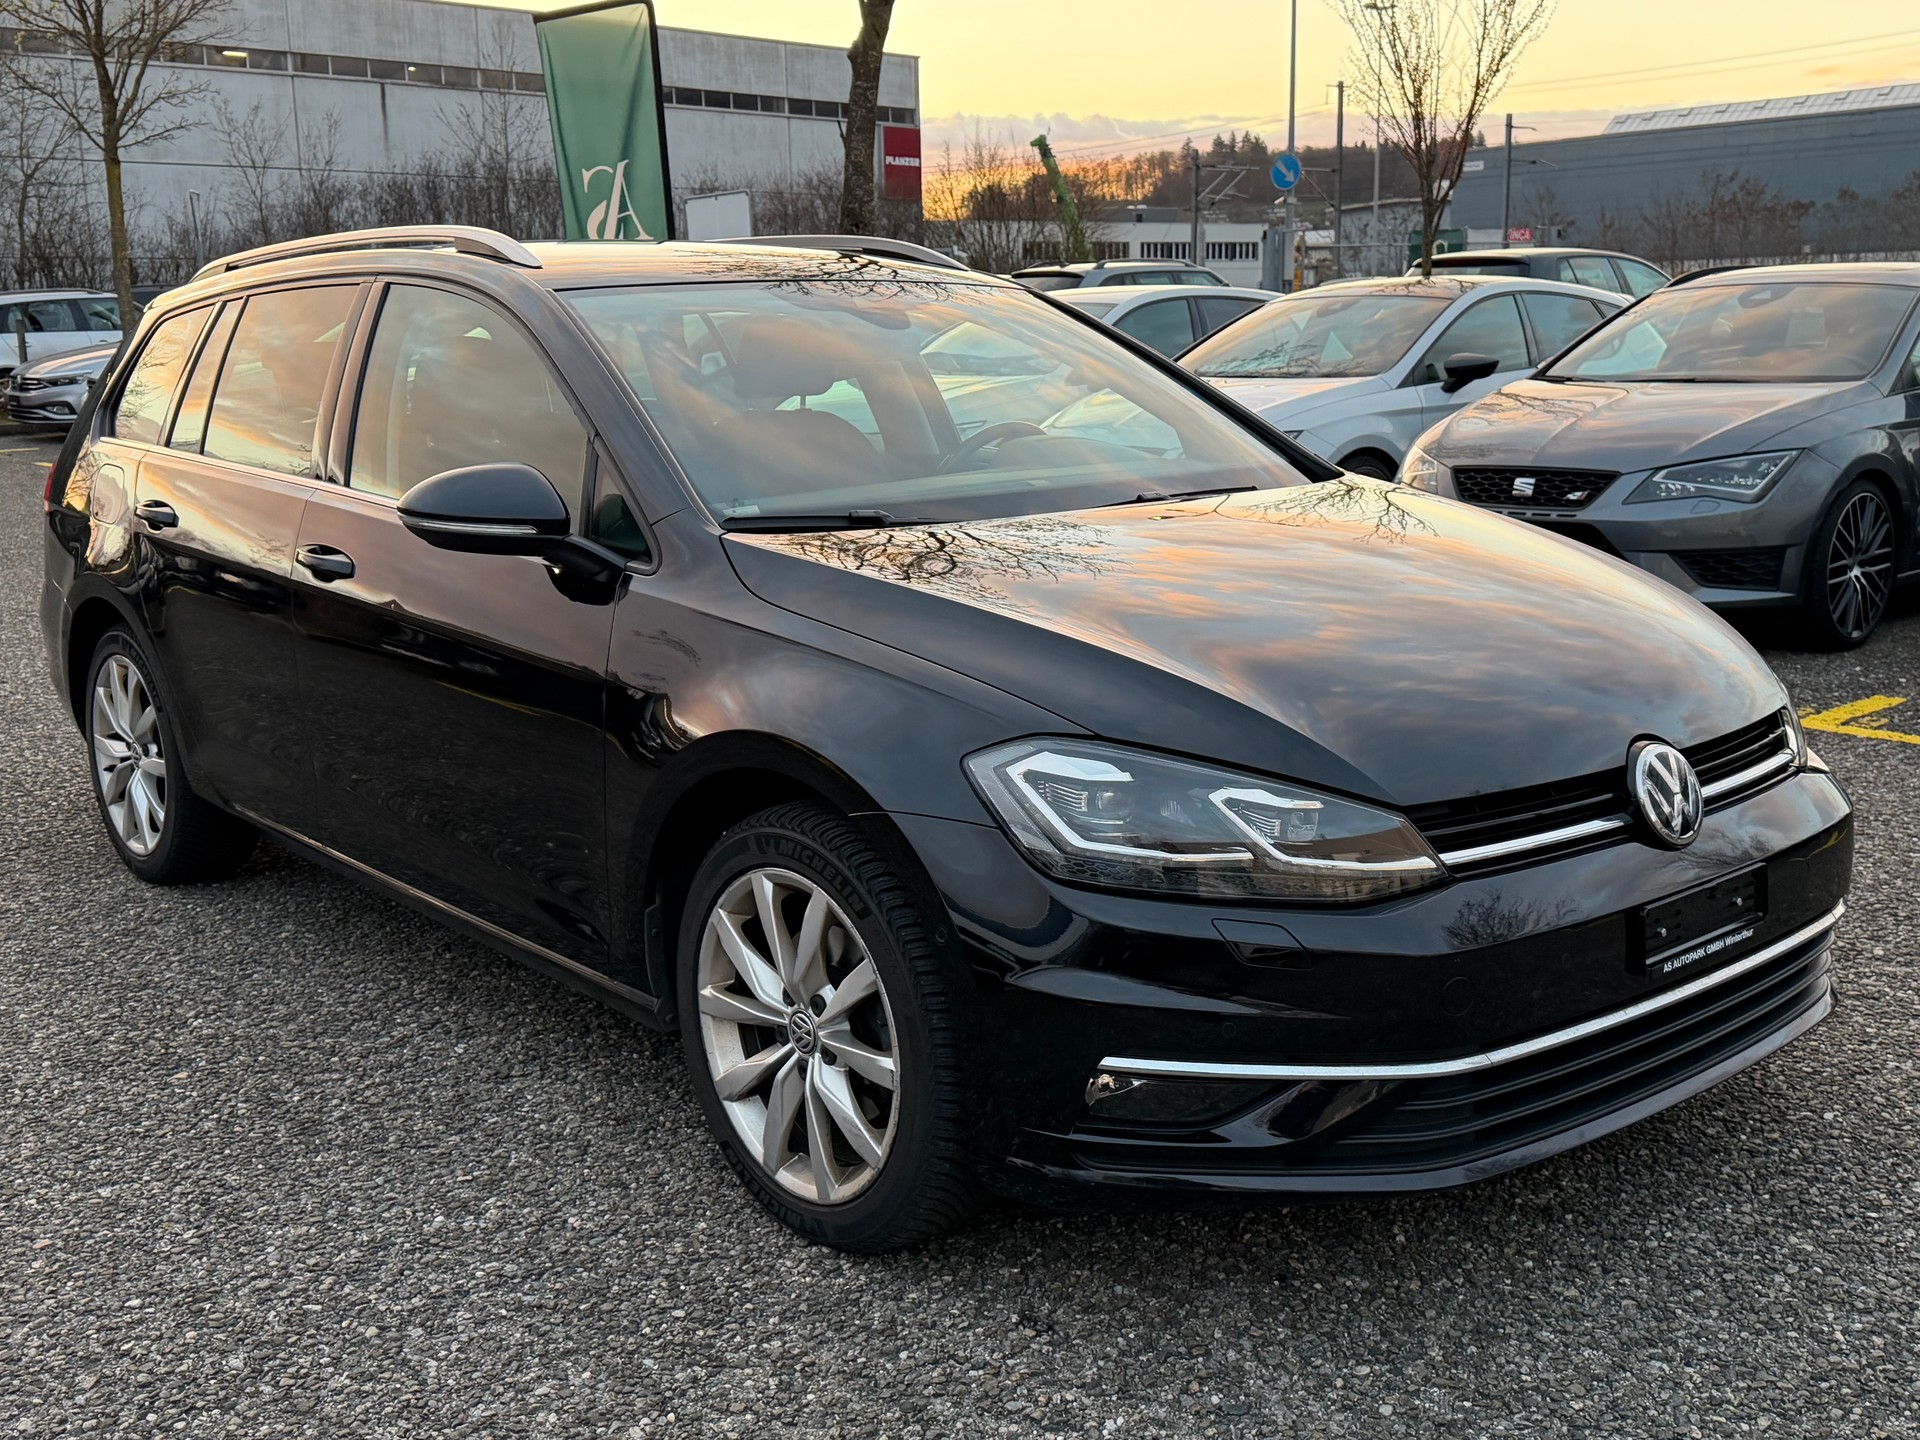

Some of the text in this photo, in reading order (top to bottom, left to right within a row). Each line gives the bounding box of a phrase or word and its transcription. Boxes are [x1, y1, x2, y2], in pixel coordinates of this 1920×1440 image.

[885, 155, 920, 167] PLANZER
[778, 840, 865, 911] MICHELIN
[1663, 928, 1754, 973] AS AUTOPARK GMBH Winterthur
